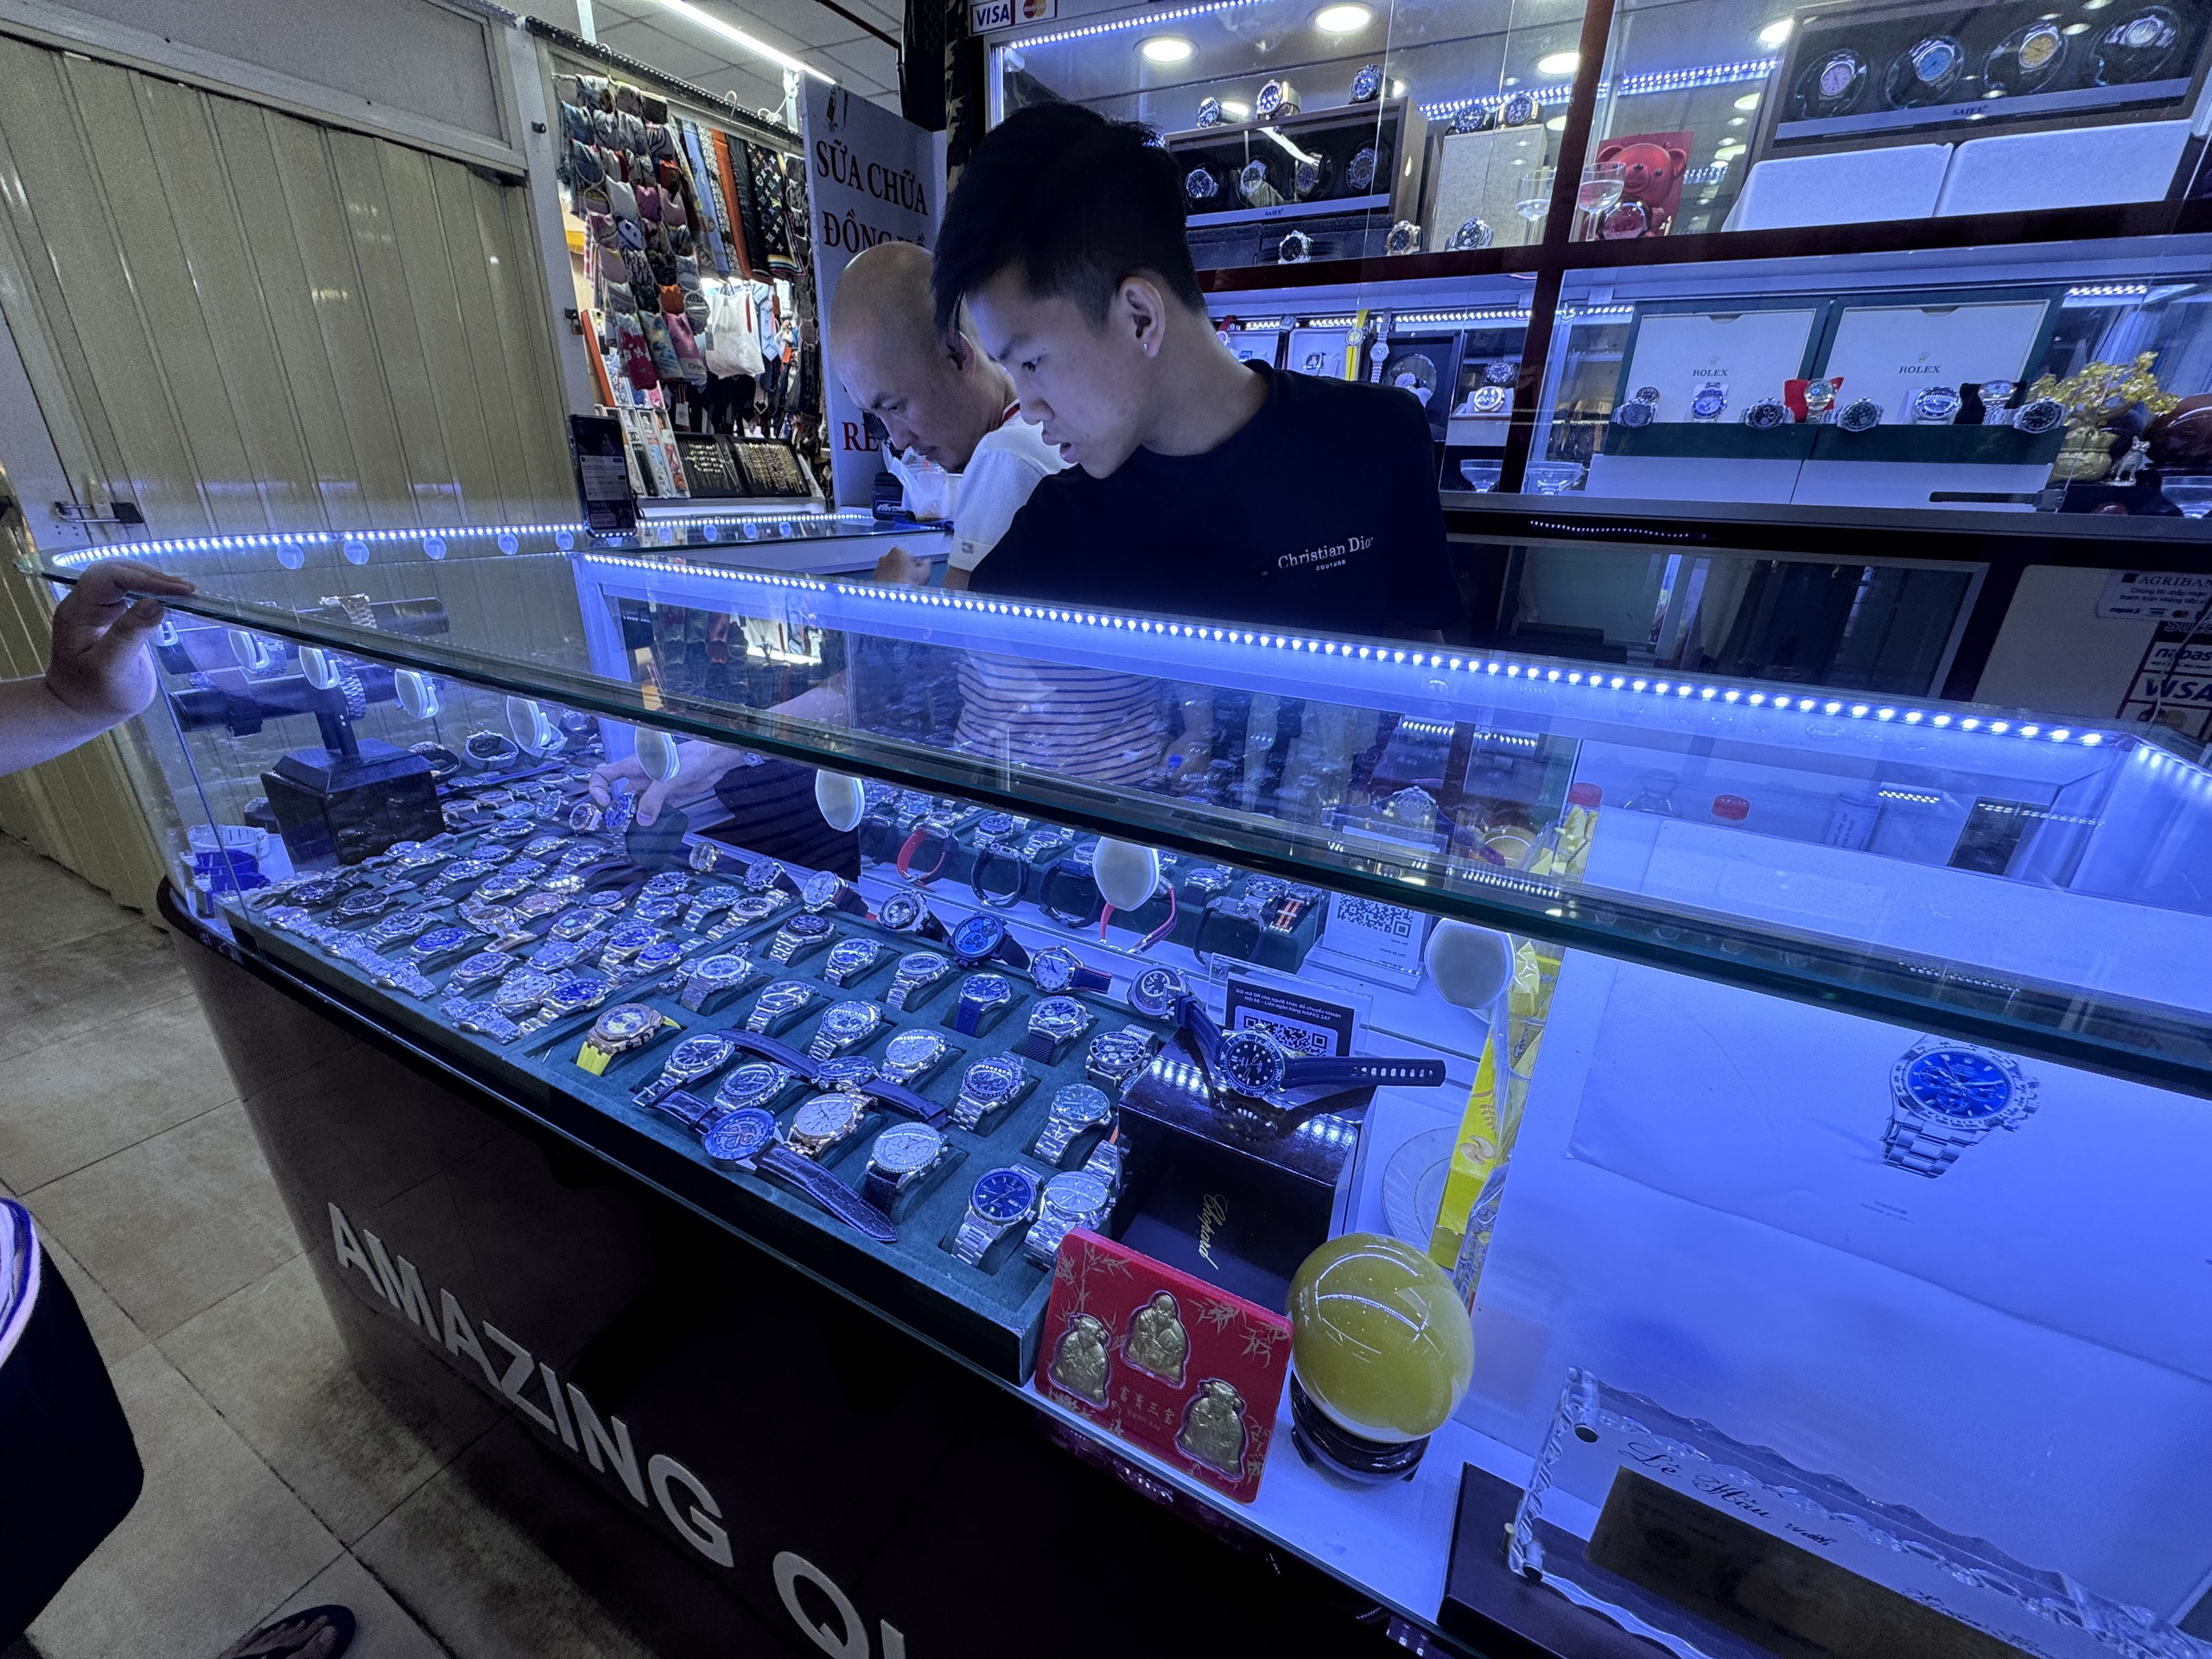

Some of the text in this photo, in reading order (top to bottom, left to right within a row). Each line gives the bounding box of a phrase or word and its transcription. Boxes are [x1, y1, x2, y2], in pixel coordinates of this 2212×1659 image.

[976, 3, 1010, 27] VISA
[816, 139, 929, 216] SỮA CHỮA
[1898, 365, 1941, 374] ROLEX
[1278, 545, 1345, 569] Christian
[1316, 559, 1346, 570] COUTURE
[1301, 1009, 1320, 1019] NAPAS
[1197, 1194, 1228, 1270] Chopard
[328, 1202, 734, 1567] AMAZING
